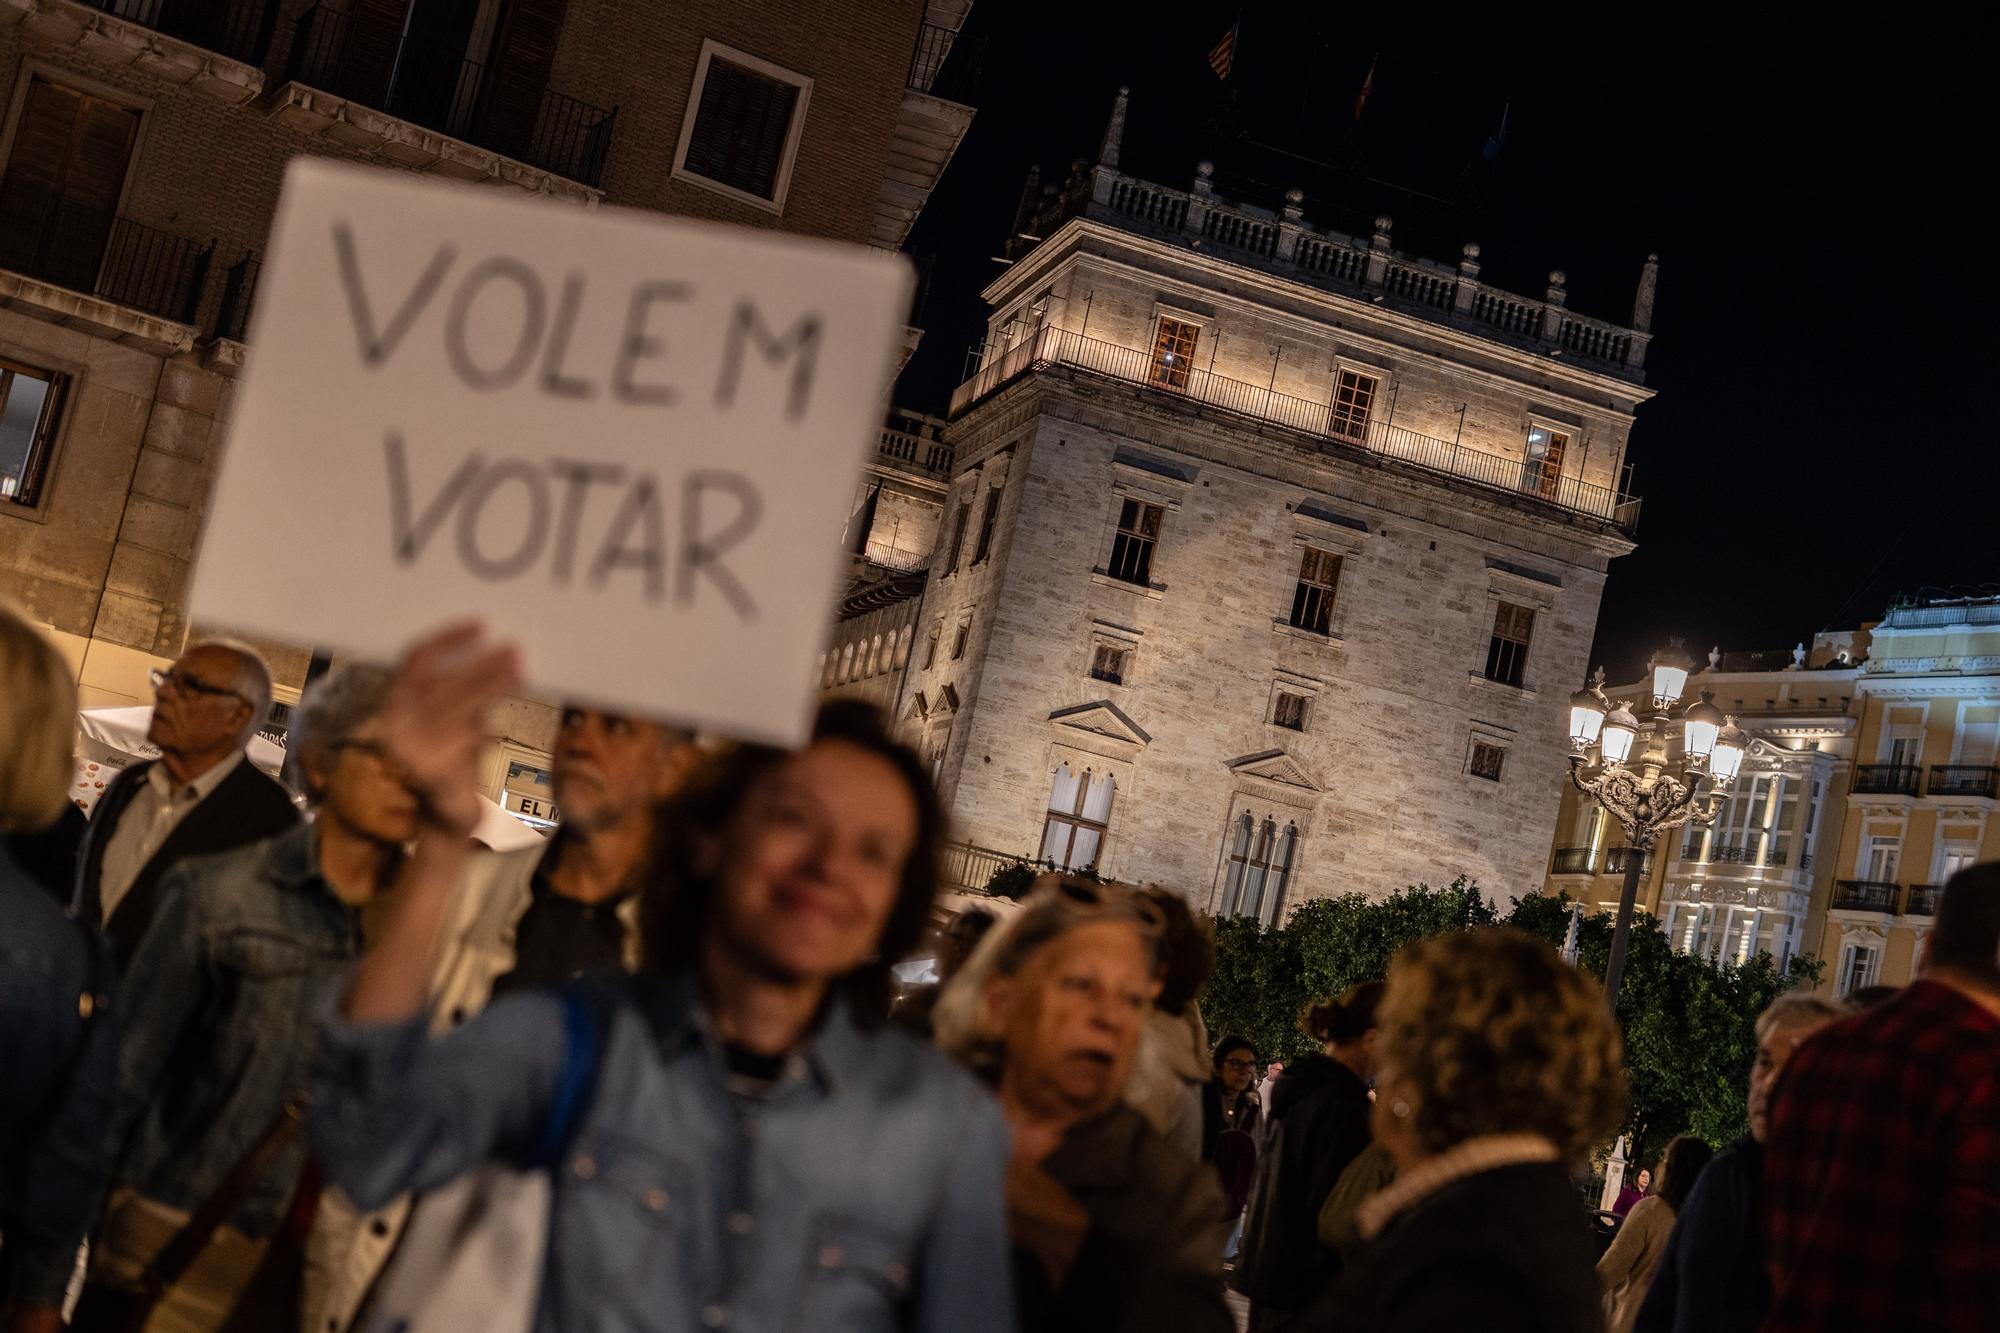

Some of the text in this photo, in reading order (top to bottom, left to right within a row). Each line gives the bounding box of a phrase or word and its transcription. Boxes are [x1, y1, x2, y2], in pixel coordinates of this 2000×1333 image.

[332, 217, 824, 425] VOLEM
[383, 429, 766, 625] VOTAR
[520, 798, 542, 817] EL
